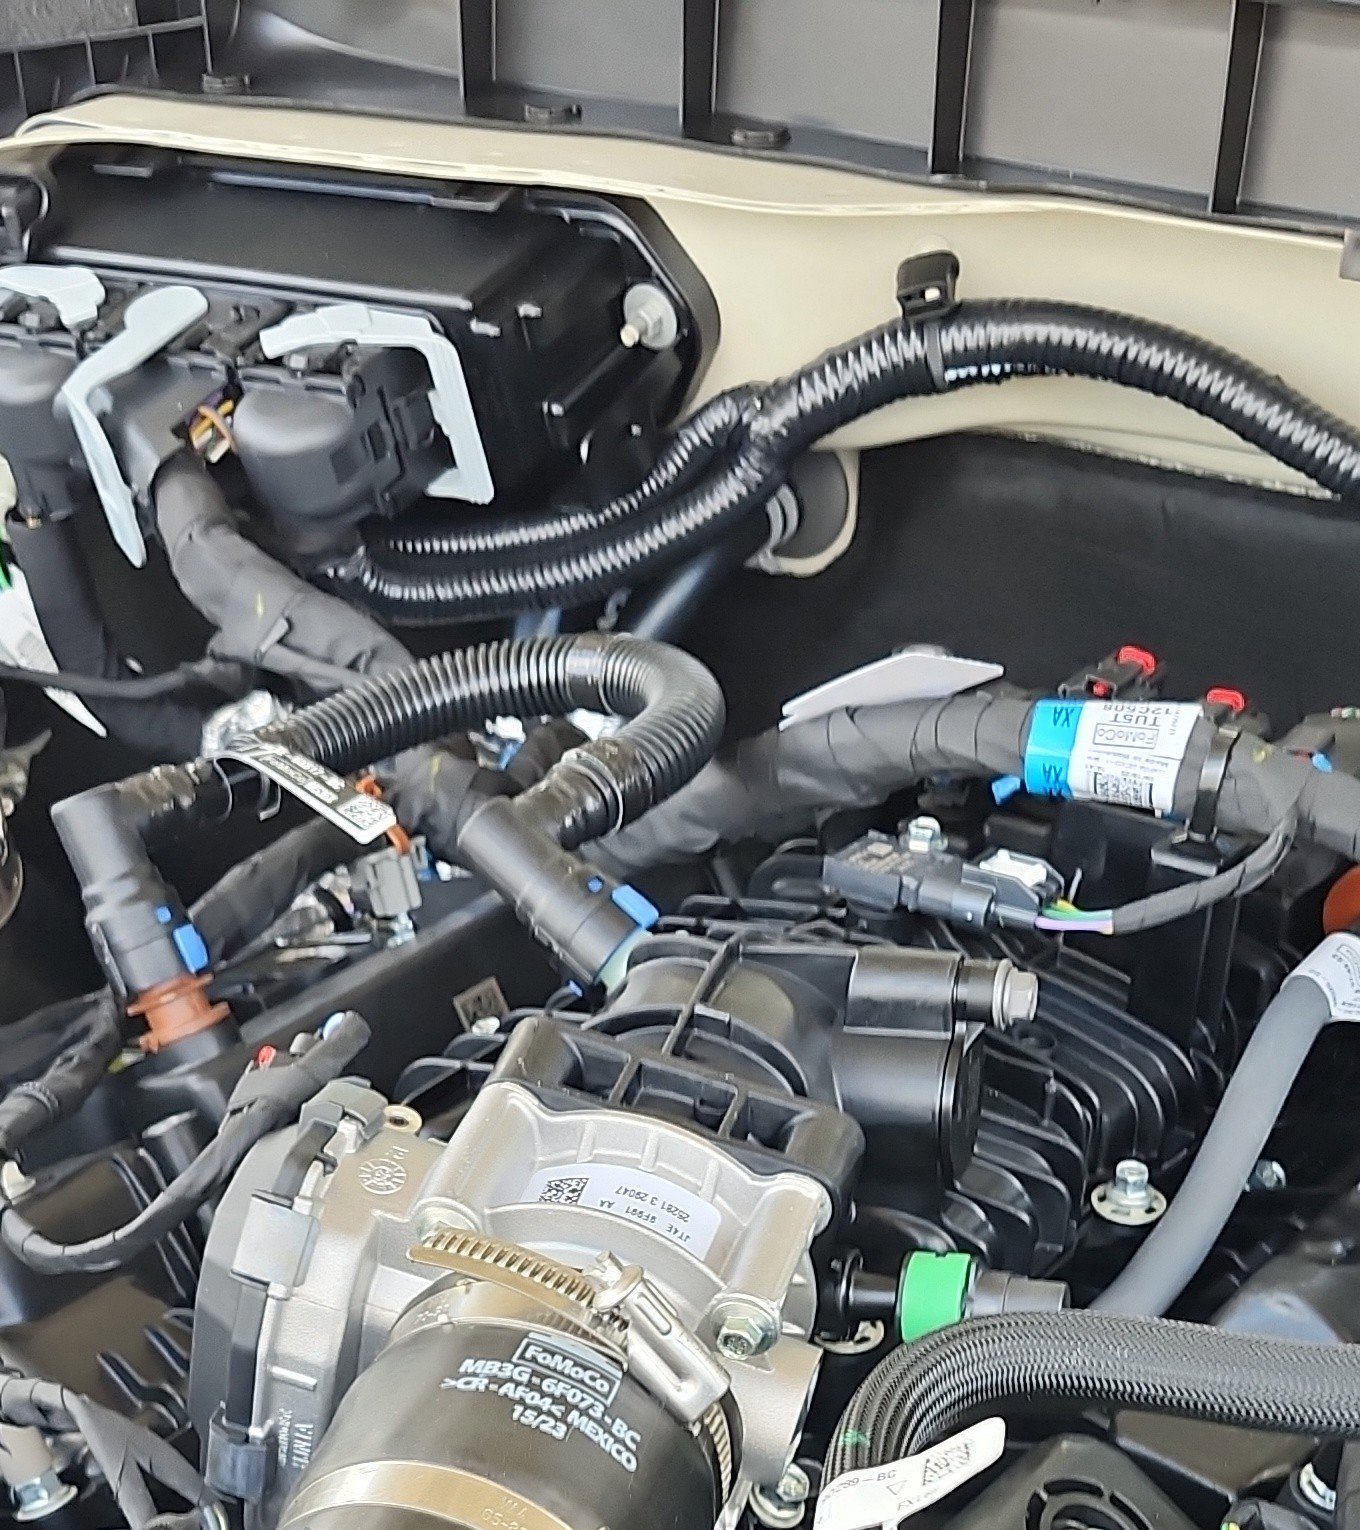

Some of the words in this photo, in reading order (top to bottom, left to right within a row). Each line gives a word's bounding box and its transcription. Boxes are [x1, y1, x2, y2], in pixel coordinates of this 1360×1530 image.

[1053, 707, 1075, 728] XA
[524, 1345, 620, 1393] FoMoCo
[567, 1409, 638, 1473] MEXICO
